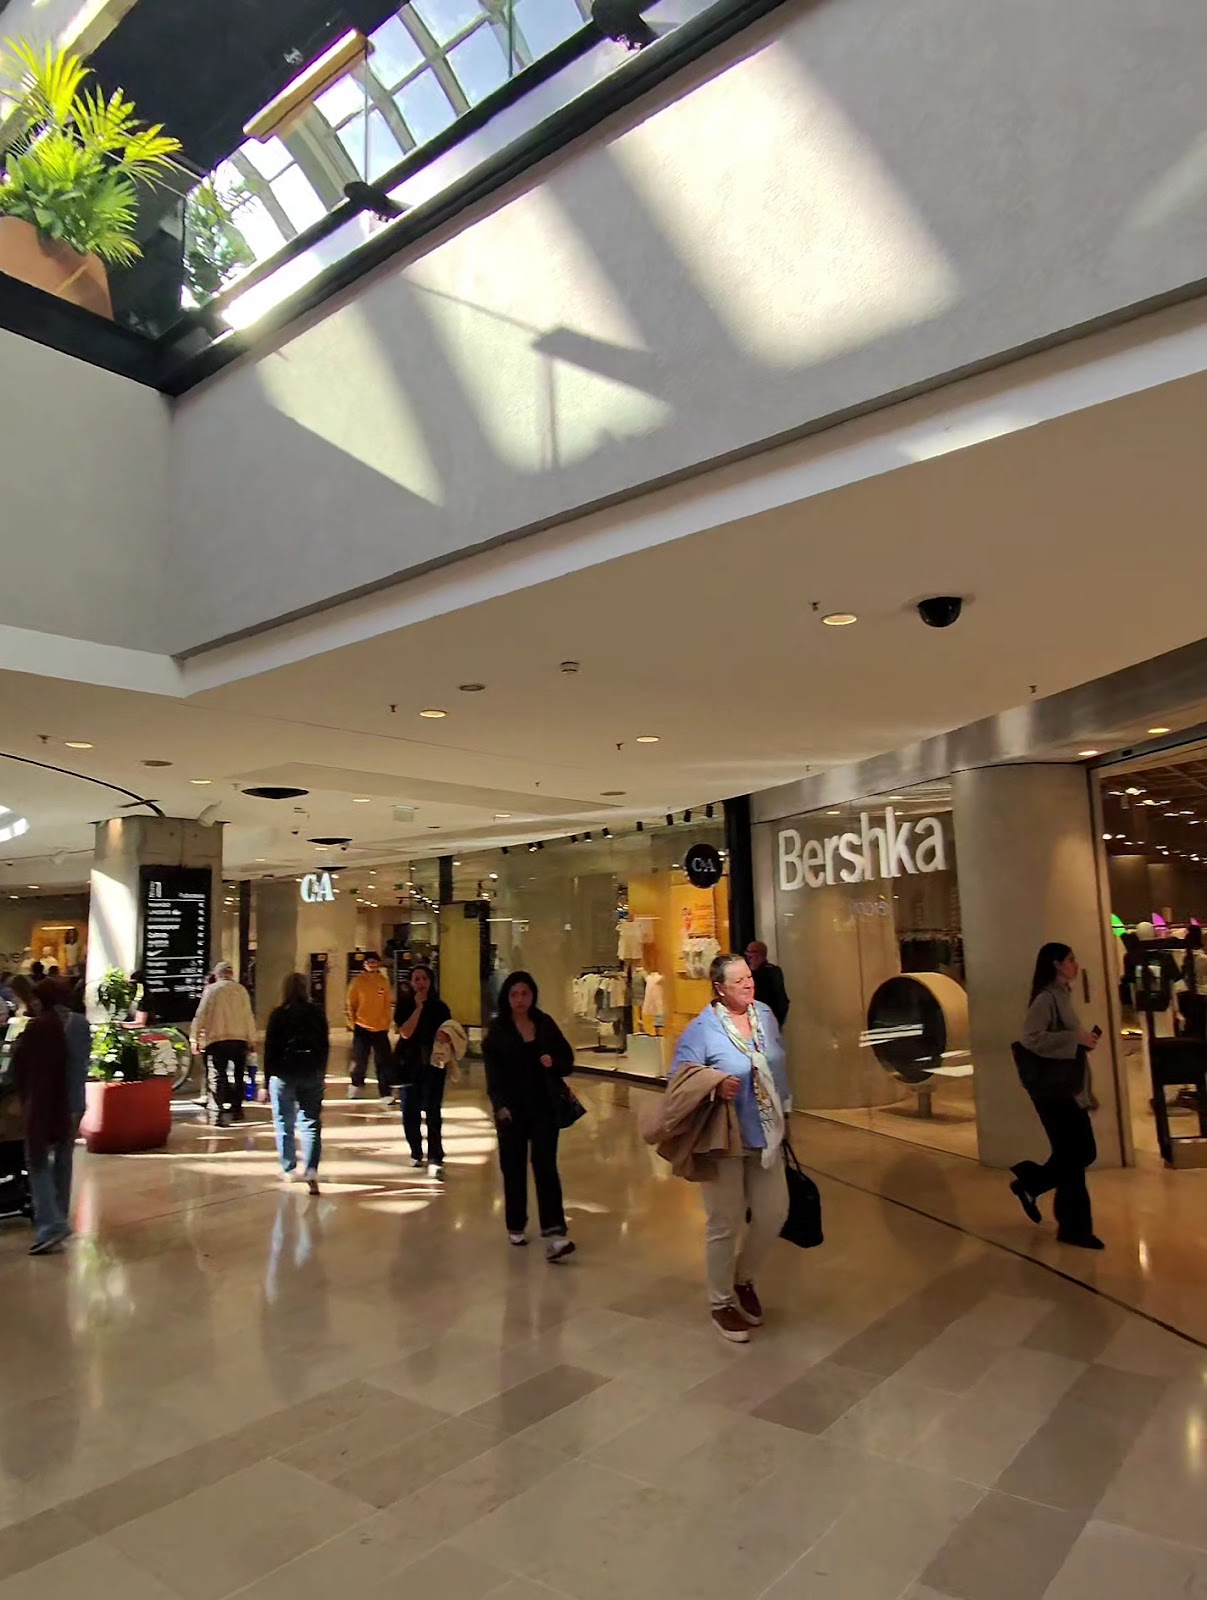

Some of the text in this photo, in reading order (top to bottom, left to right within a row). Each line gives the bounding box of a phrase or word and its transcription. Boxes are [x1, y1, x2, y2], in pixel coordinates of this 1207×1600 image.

[778, 806, 948, 891] Bershka
[692, 857, 717, 872] C&A
[300, 872, 335, 903] C&A
